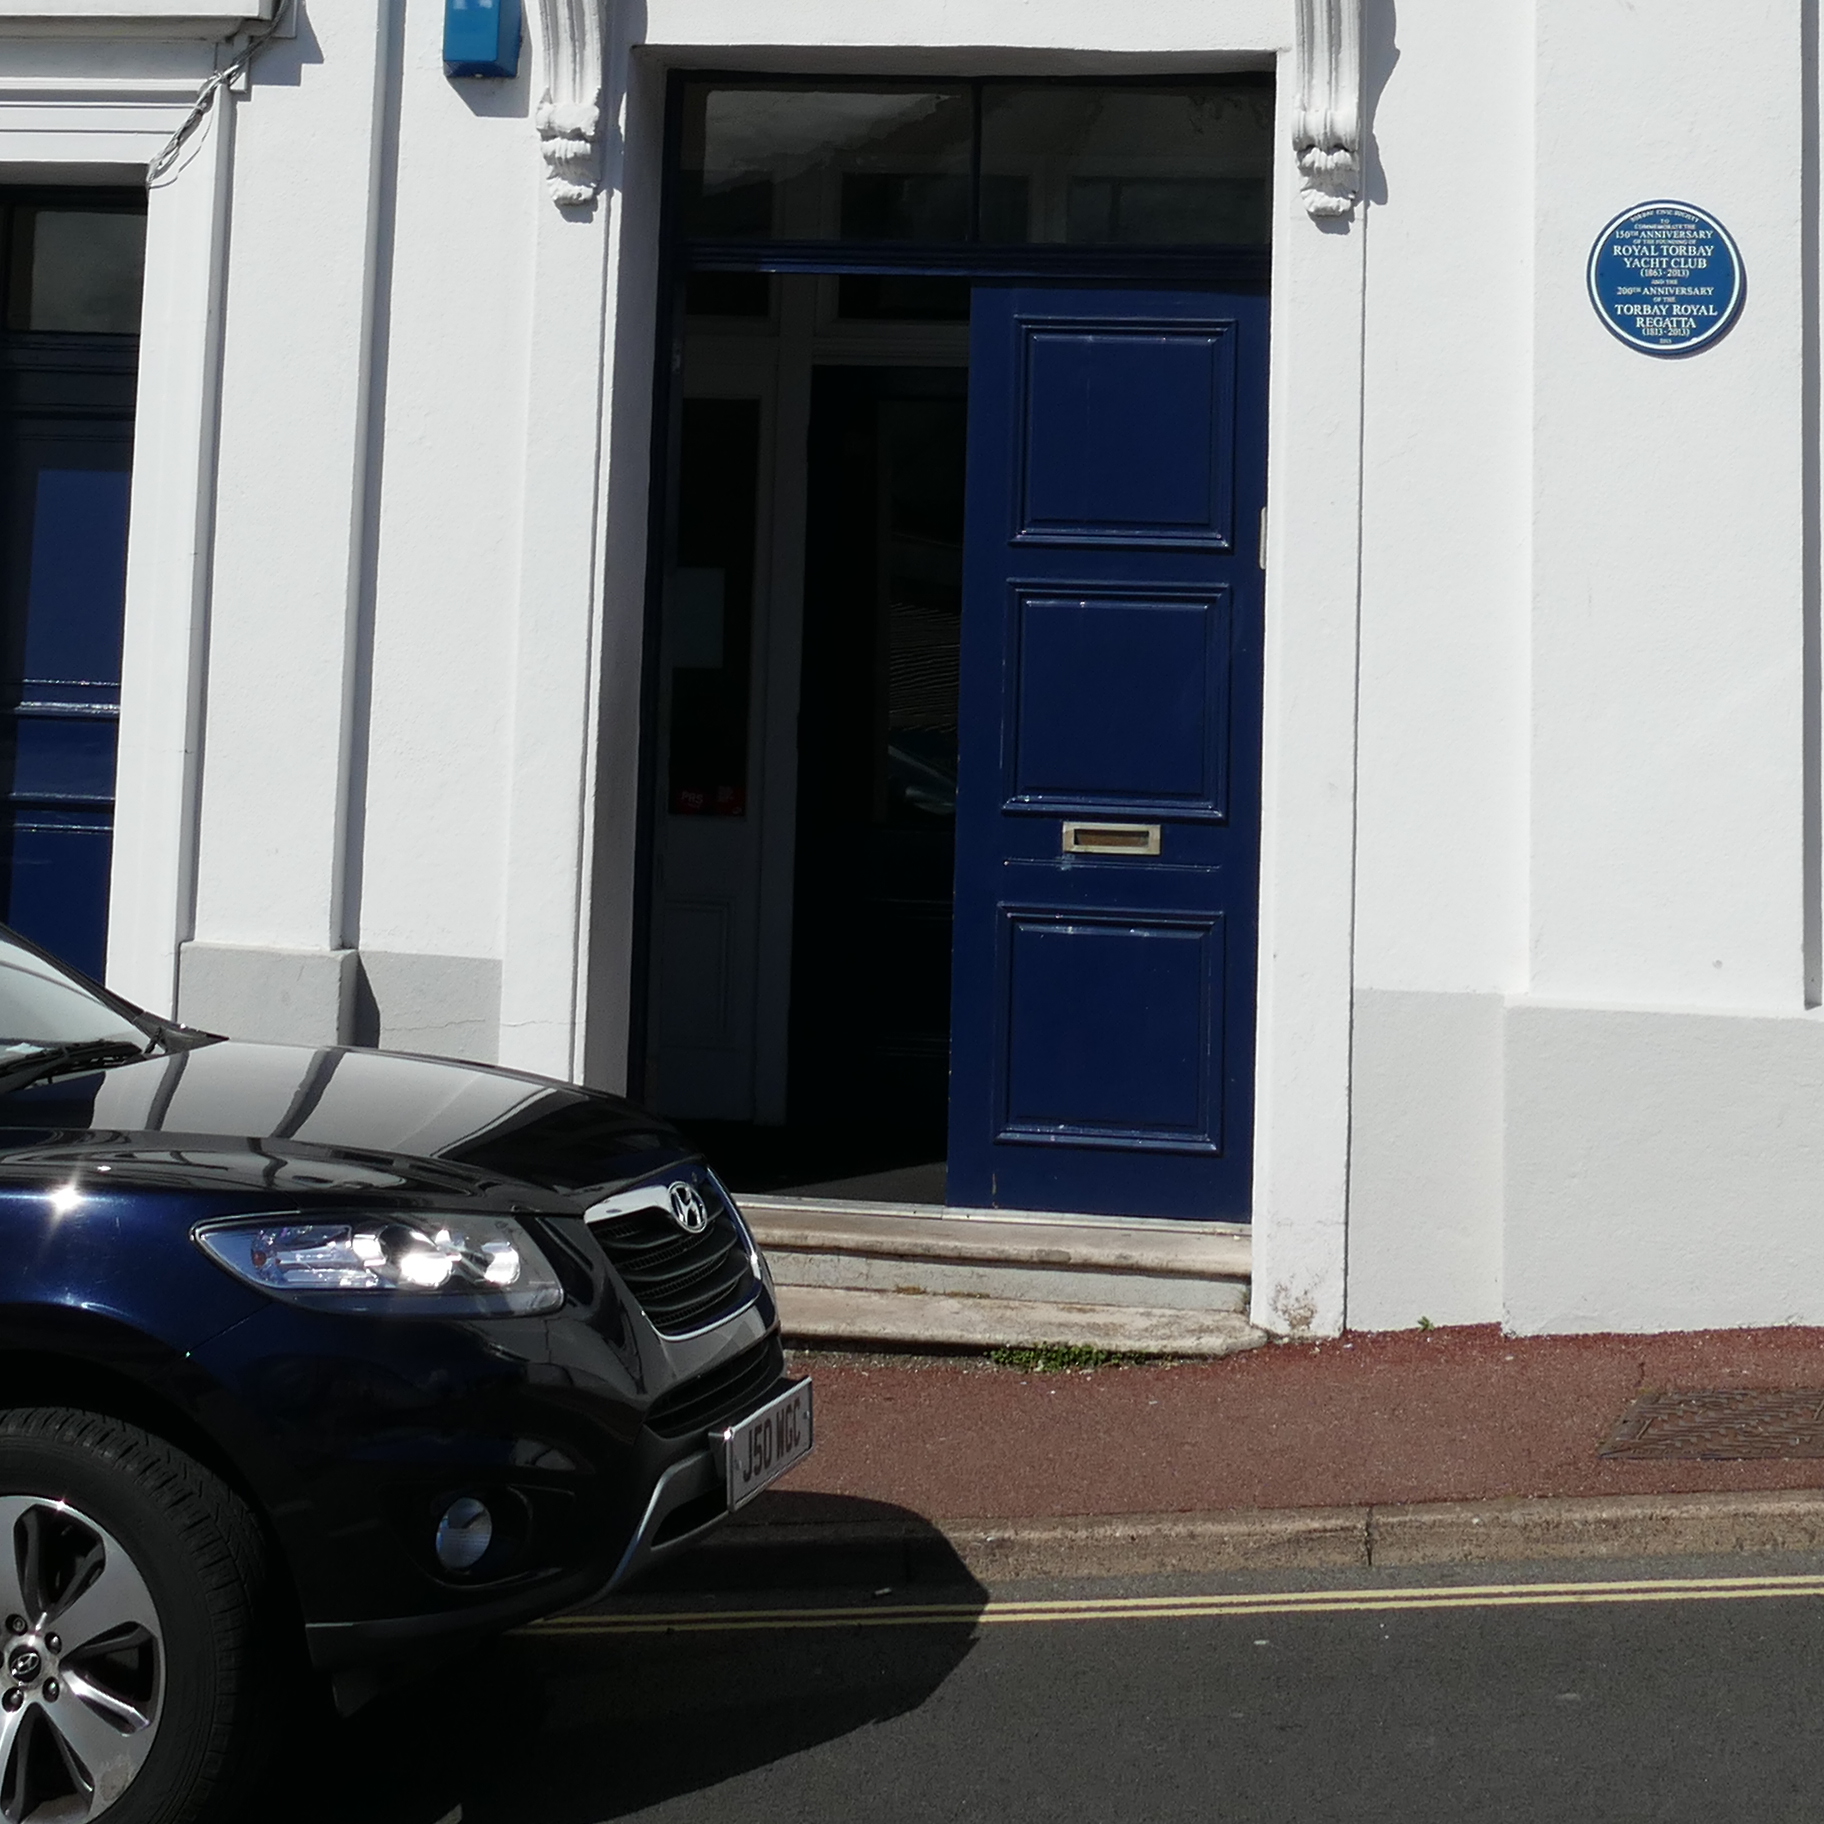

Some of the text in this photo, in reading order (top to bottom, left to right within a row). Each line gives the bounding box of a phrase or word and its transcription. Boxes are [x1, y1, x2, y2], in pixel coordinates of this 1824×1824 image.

[1640, 231, 1714, 239] ANNIVERSARY
[1613, 245, 1714, 256] ROYAL TORBAY
[1624, 257, 1707, 268] YACHT CLUB
[1642, 287, 1714, 295] ANNIVERSARY
[1615, 305, 1718, 316] TORBAY ROYAL
[1636, 318, 1696, 328] REGATTA
[743, 1419, 772, 1482] J50
